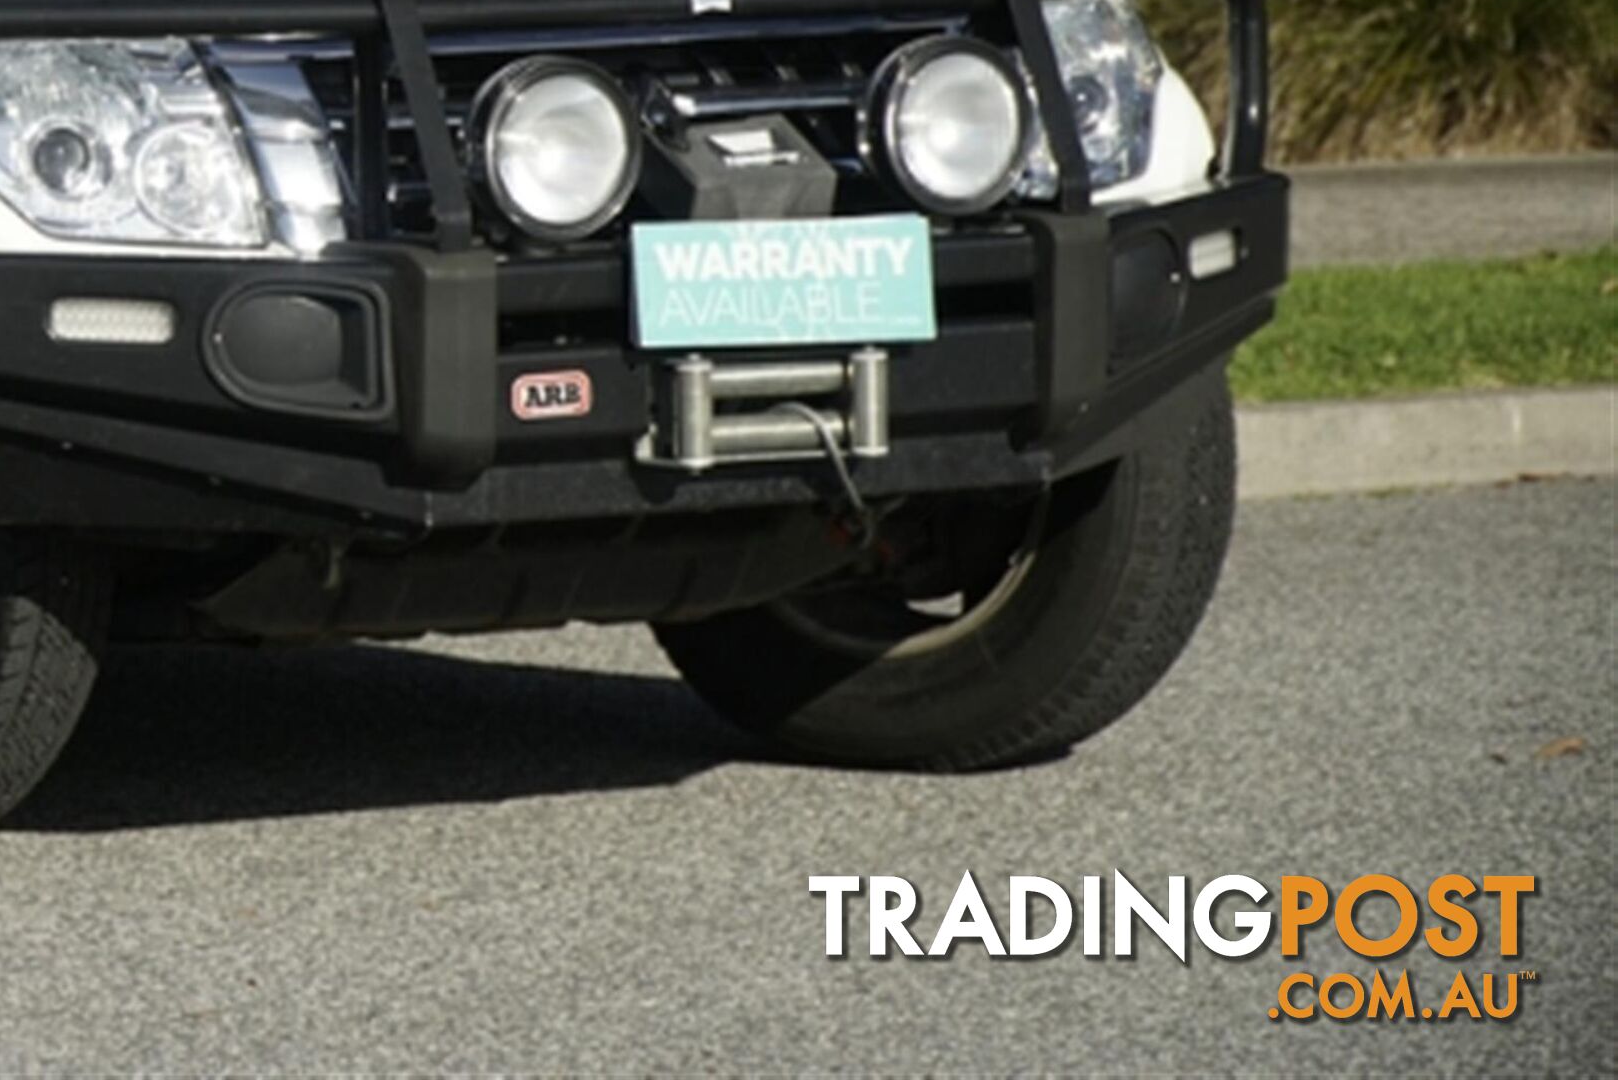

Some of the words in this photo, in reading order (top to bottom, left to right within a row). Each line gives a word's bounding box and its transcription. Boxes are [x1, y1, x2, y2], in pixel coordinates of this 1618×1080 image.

[654, 236, 913, 282] WARRANTY
[660, 281, 882, 326] AVAILABLE
[524, 383, 581, 408] ARB
